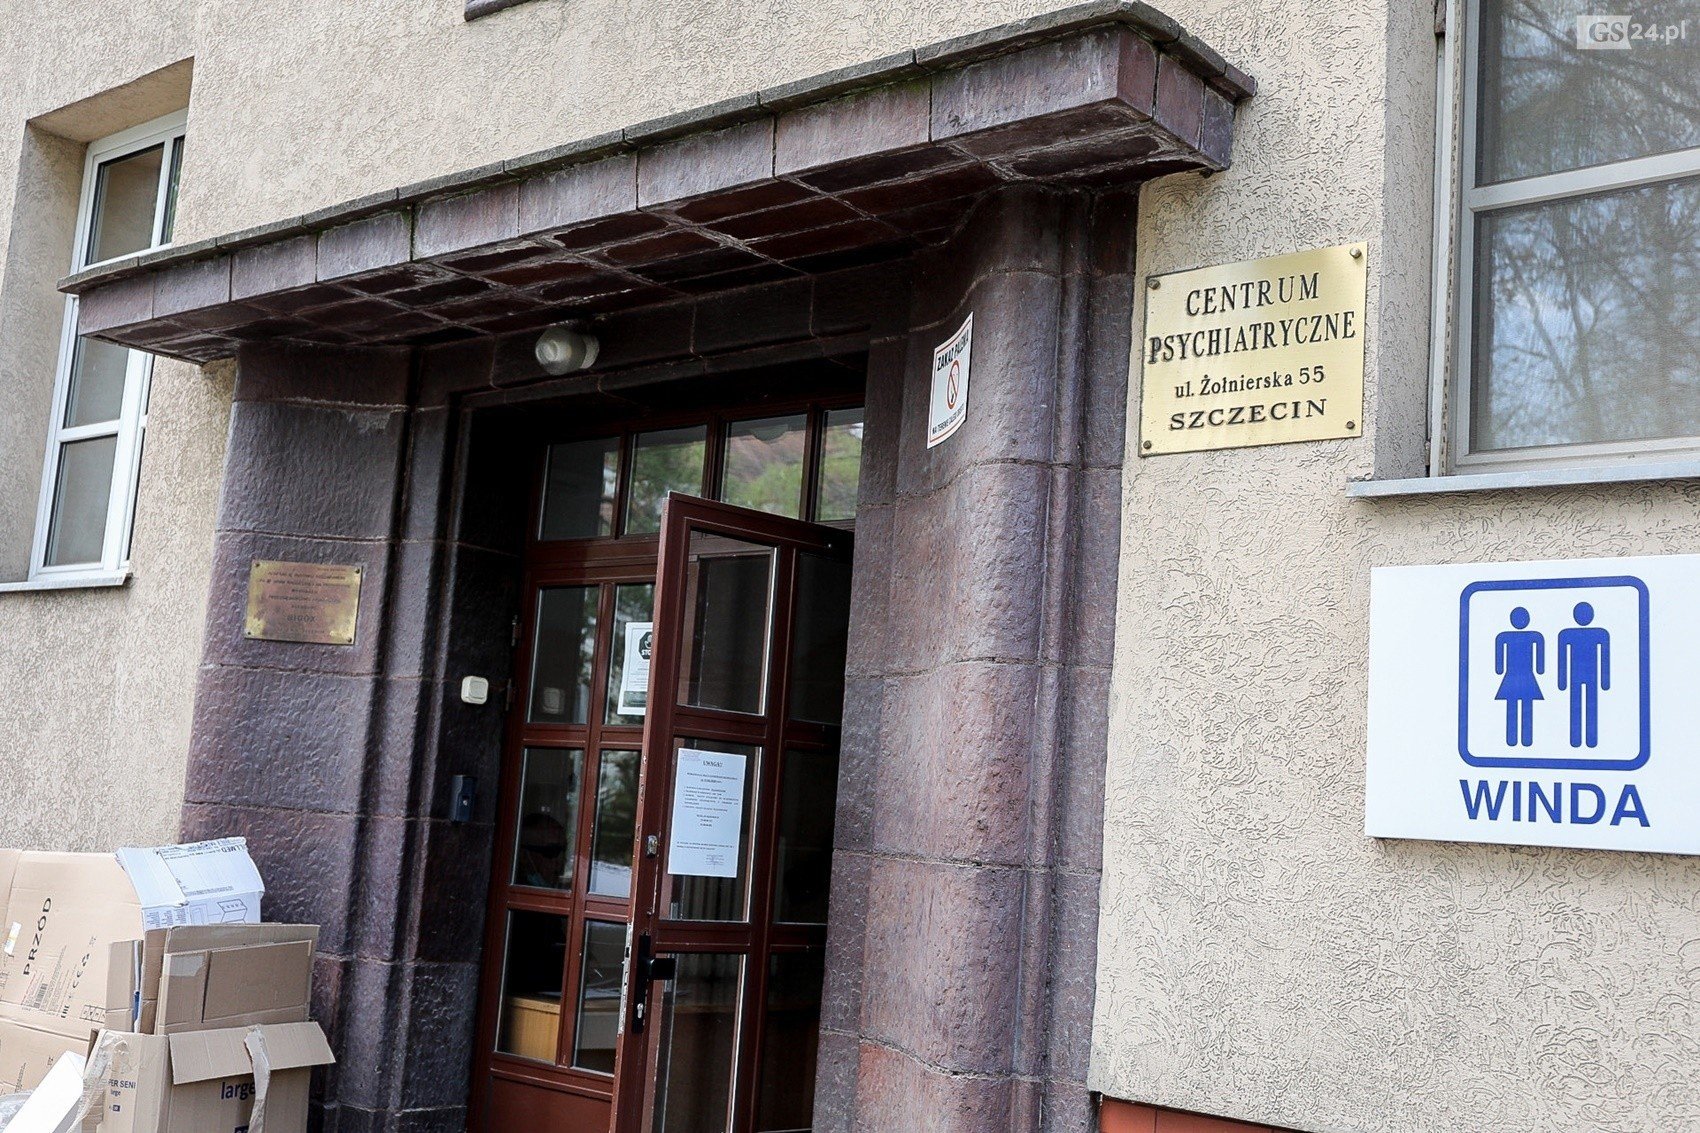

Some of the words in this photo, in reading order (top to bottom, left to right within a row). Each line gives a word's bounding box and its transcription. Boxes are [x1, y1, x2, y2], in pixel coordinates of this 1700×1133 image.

[1186, 272, 1320, 317] CENTRUM
[1148, 311, 1356, 364] PSYCHIATRYCZNE
[1175, 380, 1195, 398] ul.
[1200, 371, 1293, 396] Żołnierska
[1299, 365, 1325, 384] 55
[1170, 398, 1328, 430] SZCZECIN
[1459, 779, 1651, 828] WINDA
[23, 897, 52, 976] PRZÓD
[221, 1081, 256, 1101] large
